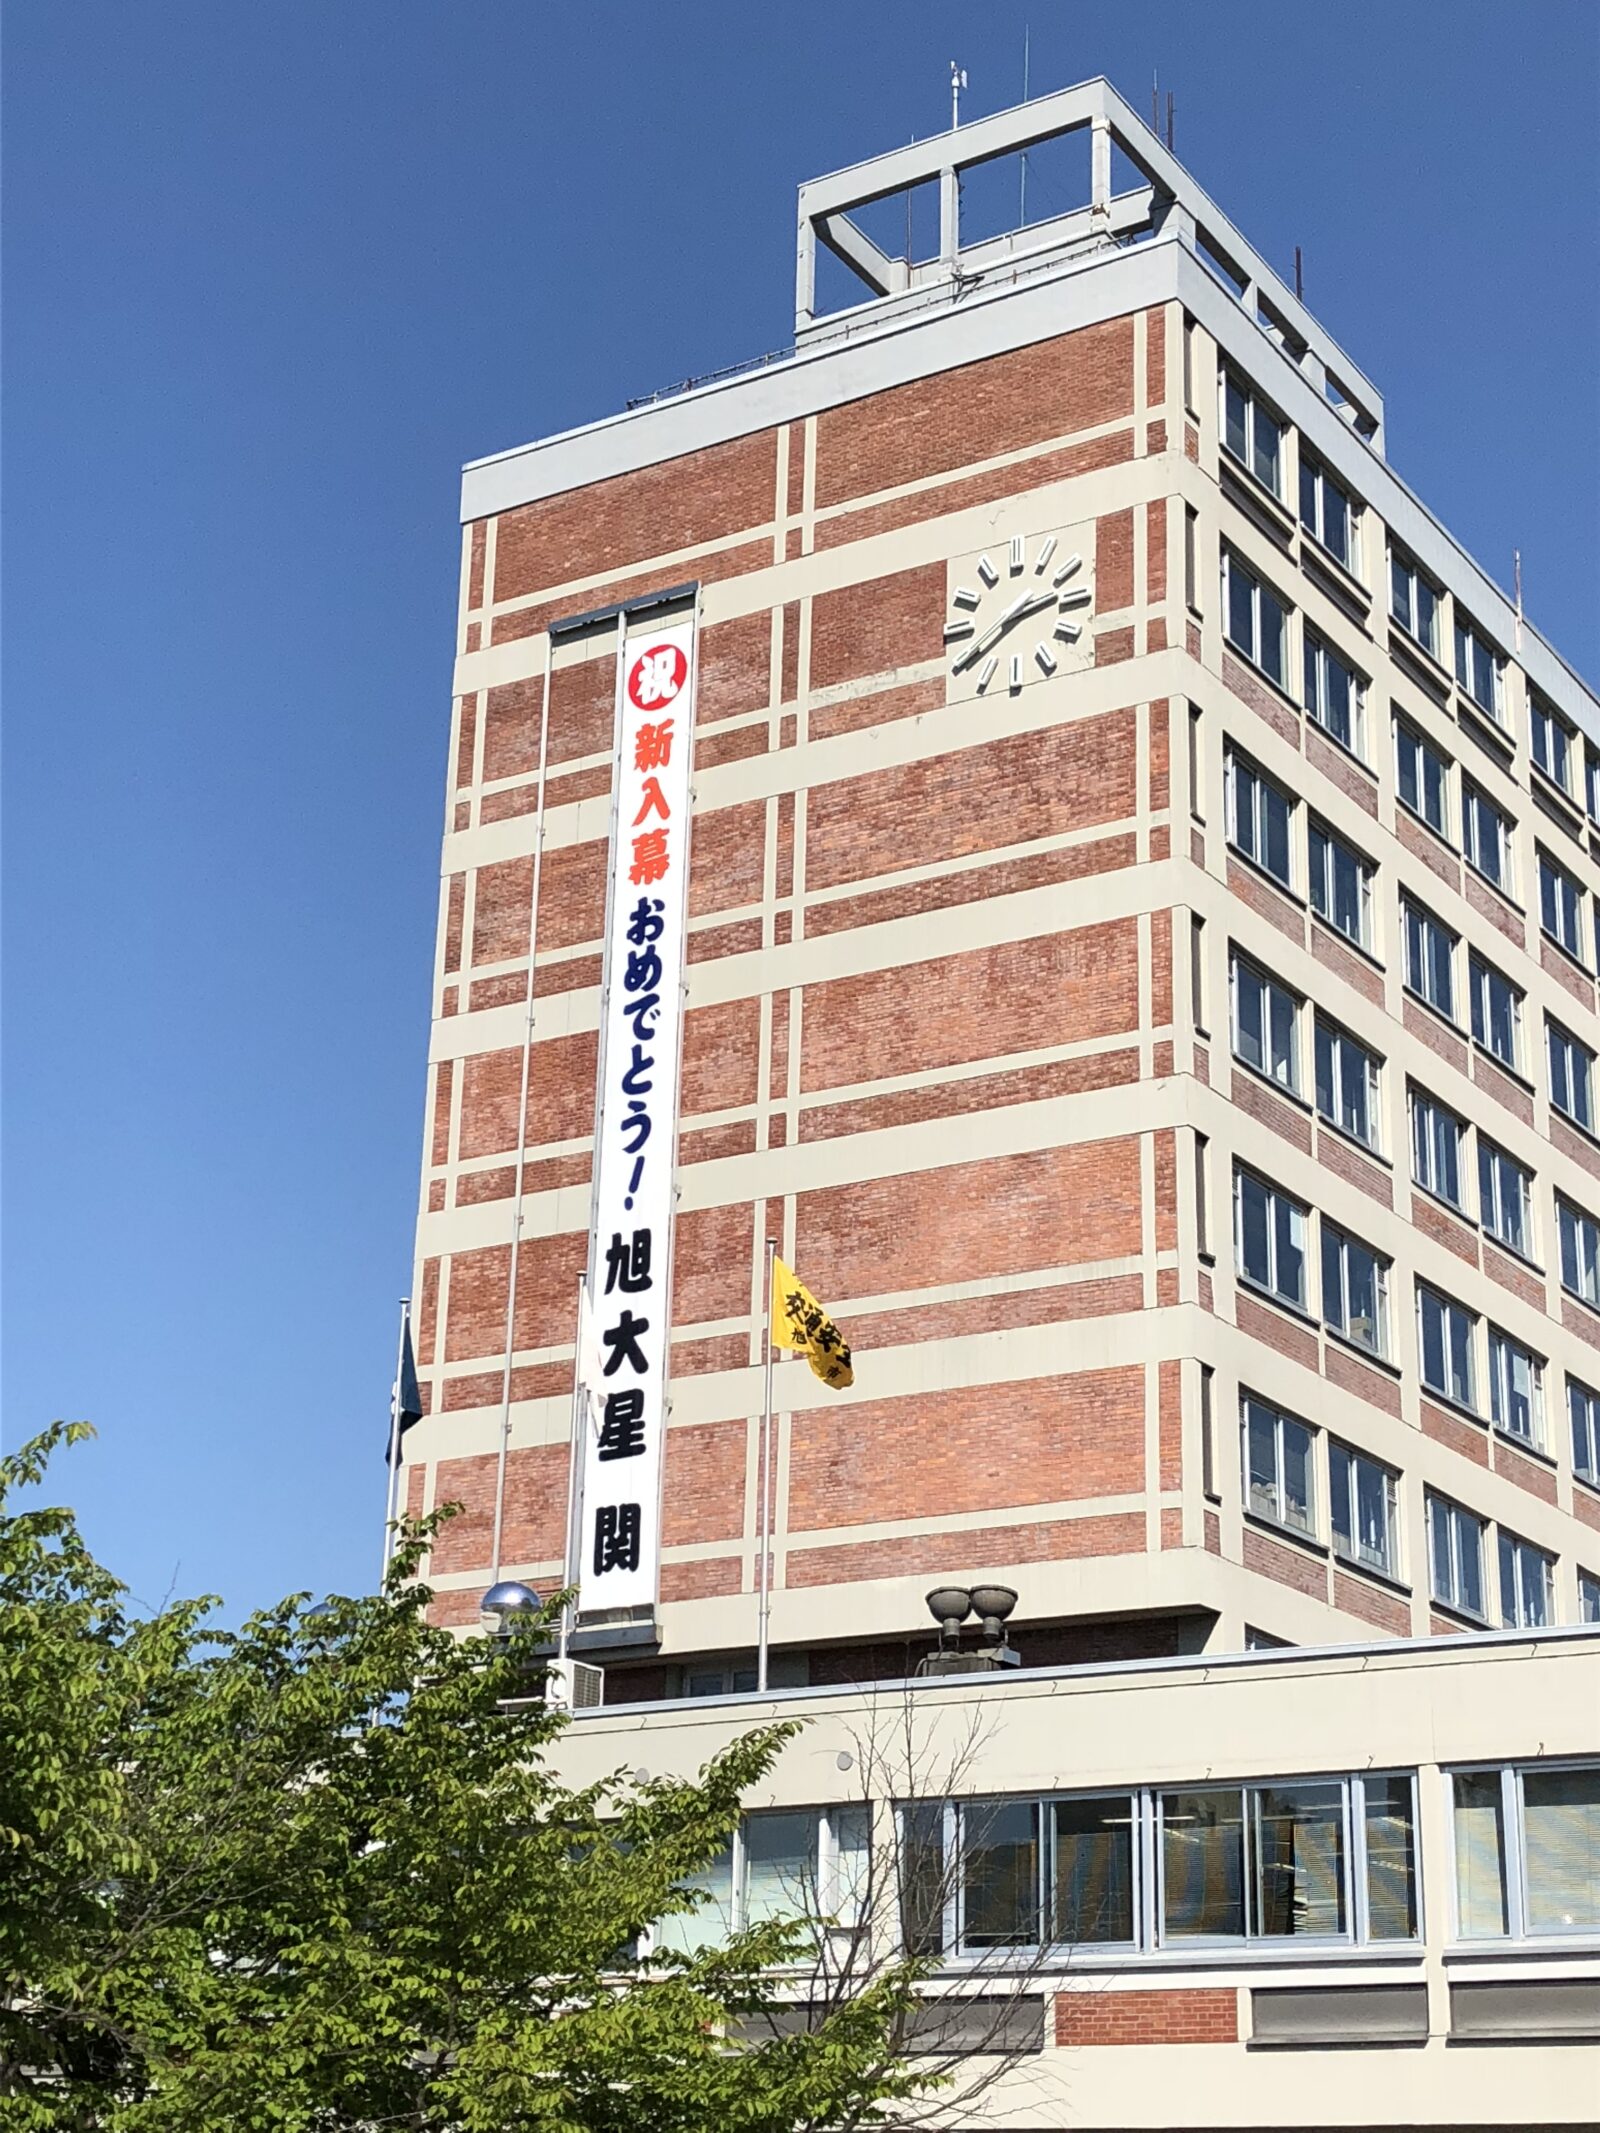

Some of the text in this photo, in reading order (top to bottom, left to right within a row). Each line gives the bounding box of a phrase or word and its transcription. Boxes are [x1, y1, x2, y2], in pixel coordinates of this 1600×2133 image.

[637, 648, 677, 705] 祝
[628, 718, 675, 885] 新入幕
